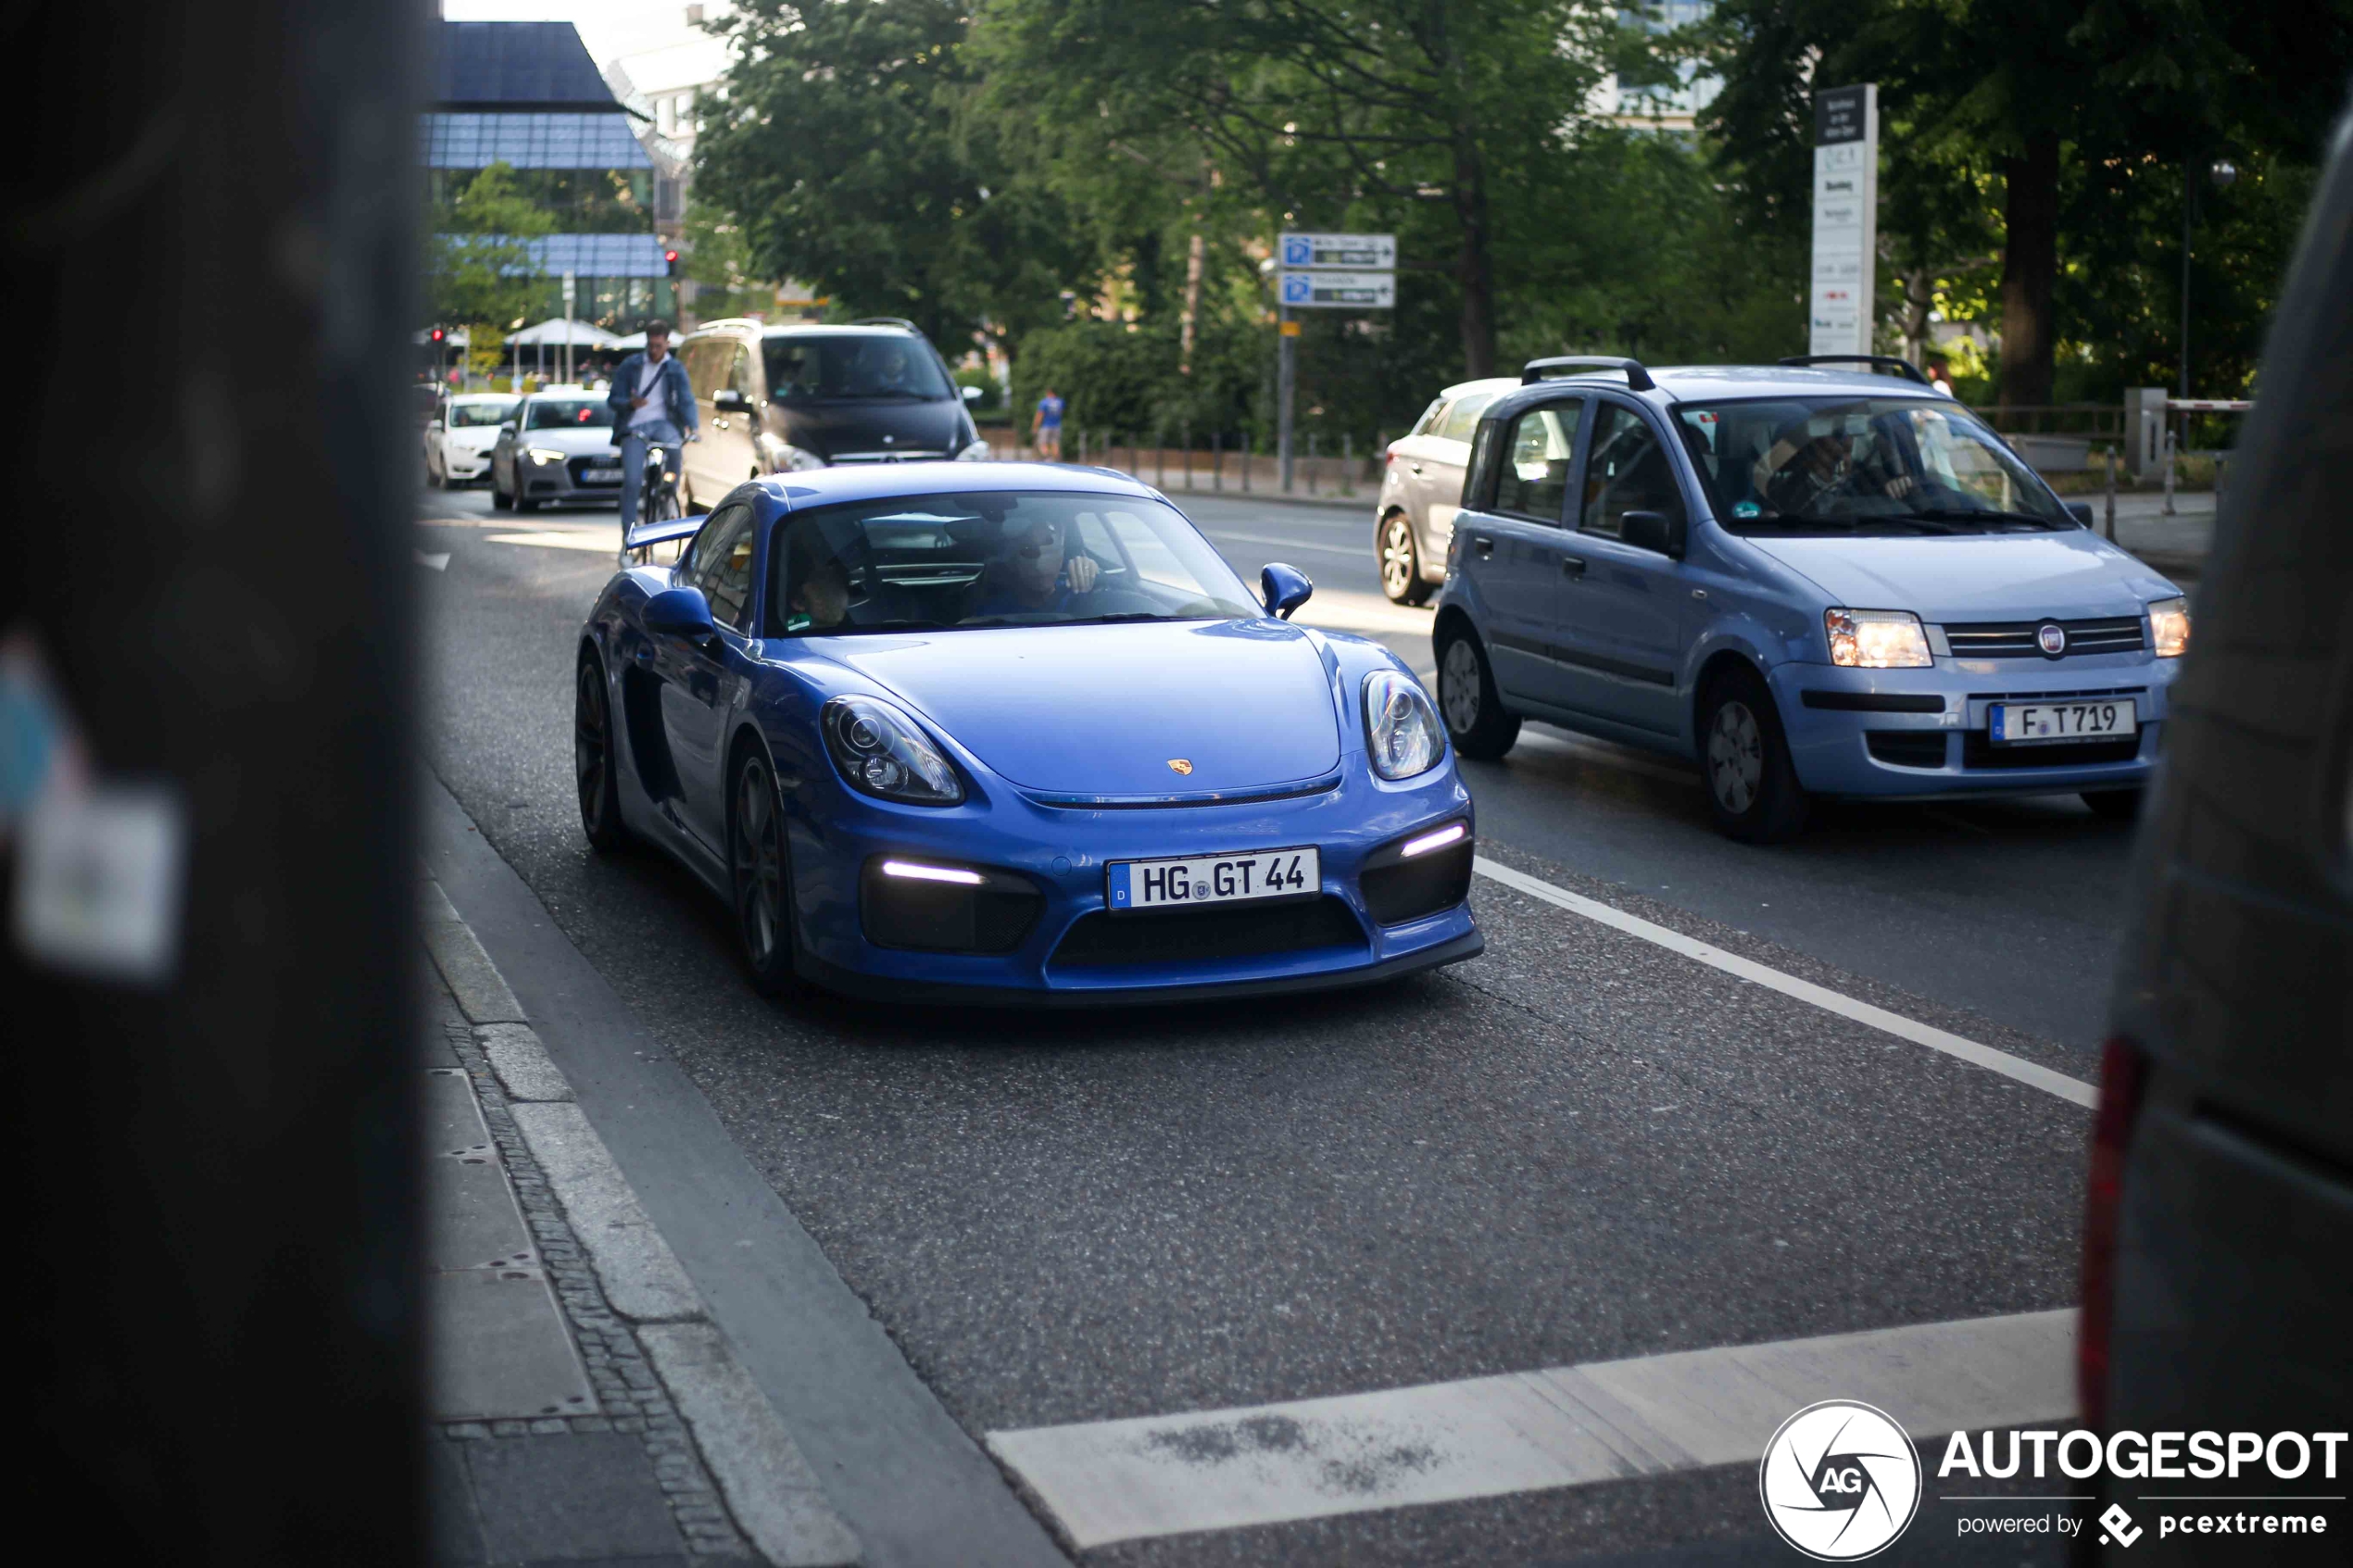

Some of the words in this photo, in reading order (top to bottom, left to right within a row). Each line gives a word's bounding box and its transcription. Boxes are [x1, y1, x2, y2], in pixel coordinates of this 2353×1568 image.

[2022, 709, 2037, 735] F
[2052, 707, 2068, 734] T
[2072, 705, 2117, 732] 719
[1143, 865, 1190, 902] HG
[1214, 859, 1256, 897] GT
[1265, 855, 1304, 891] 44
[1117, 890, 1126, 900] D
